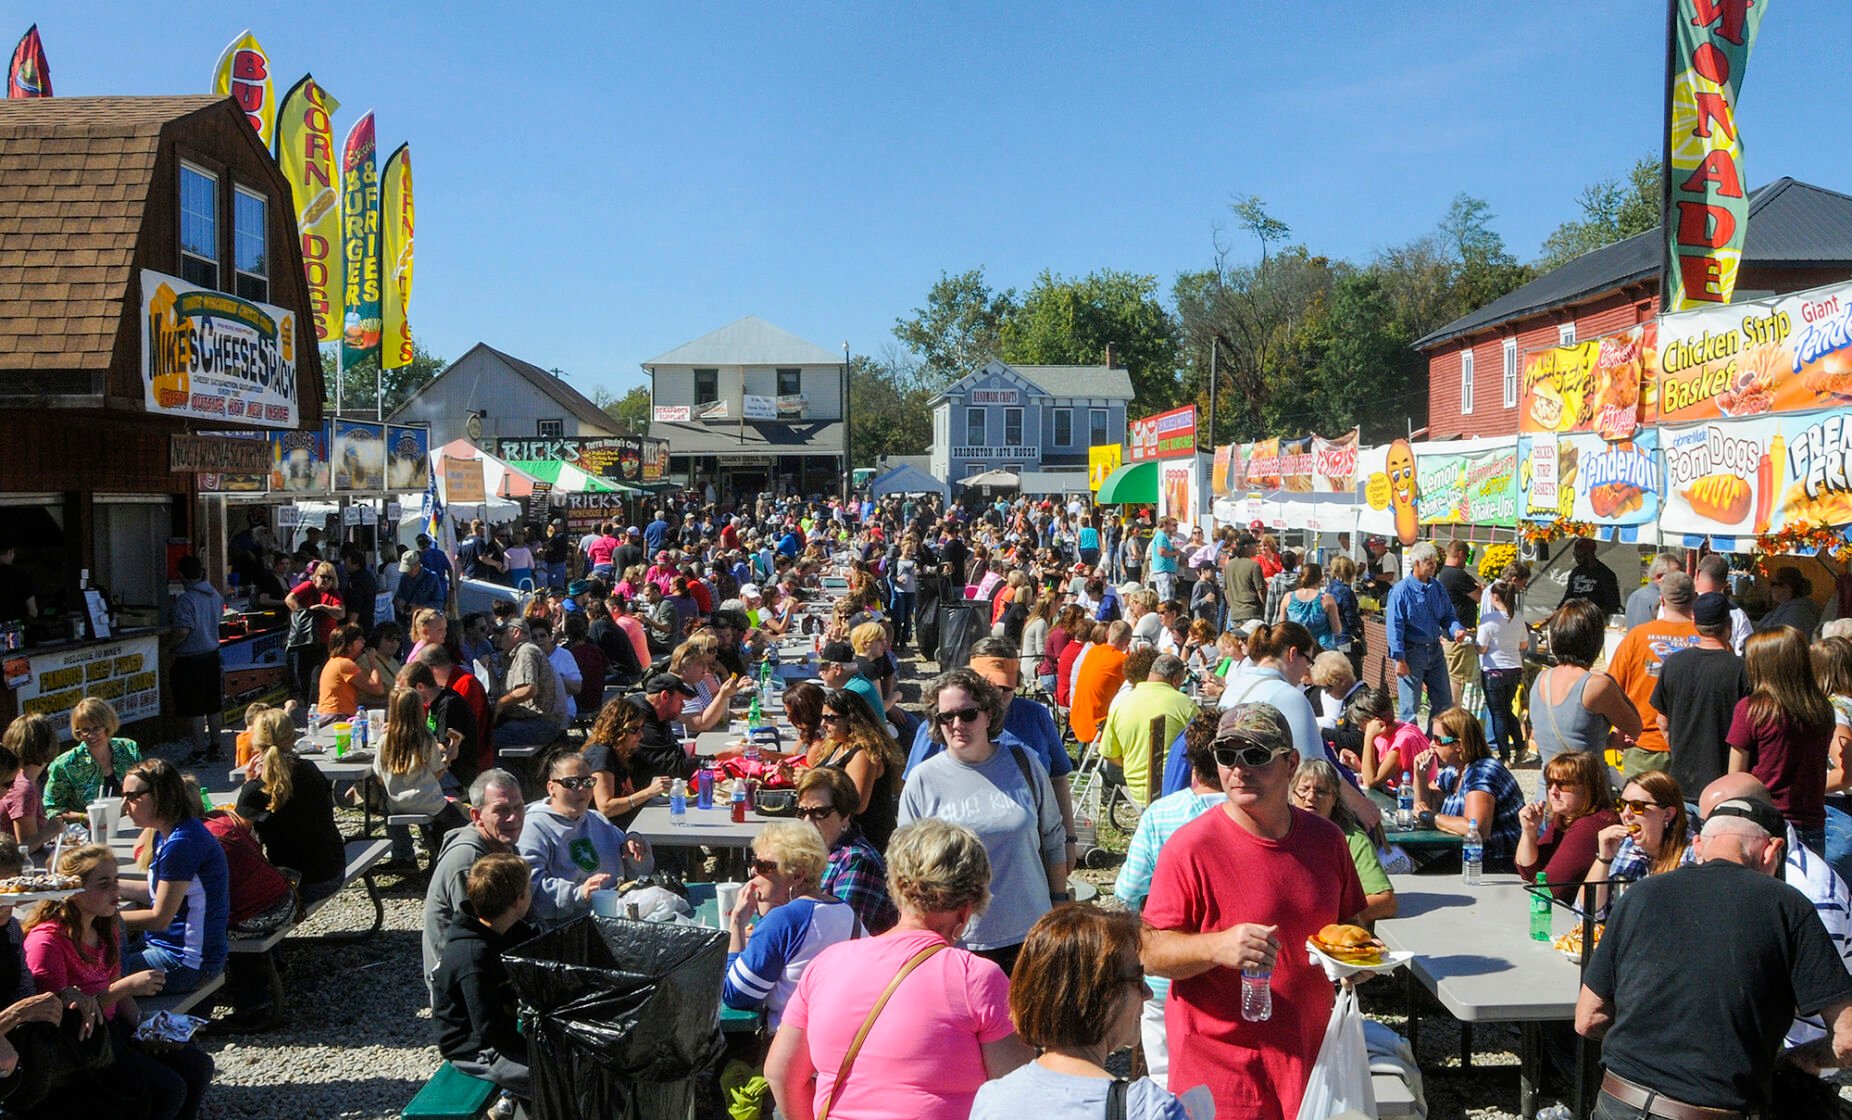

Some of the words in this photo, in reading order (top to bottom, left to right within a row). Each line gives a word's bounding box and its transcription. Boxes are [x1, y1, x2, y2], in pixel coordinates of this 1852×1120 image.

[304, 82, 330, 187] CORN
[344, 169, 365, 306] BURGER
[363, 186, 379, 302] FRIES
[1802, 294, 1839, 323] Giant
[1663, 328, 1739, 375] Chicken
[1742, 308, 1791, 349] Strip
[1664, 359, 1737, 413] Basket
[501, 439, 580, 461] RICK'S
[954, 447, 993, 457] BRIDGETON
[1014, 447, 1036, 457] HOUSE
[1534, 445, 1555, 459] CHICKEN
[1666, 443, 1712, 487] Corn
[1708, 426, 1760, 479] Dogs
[1421, 461, 1459, 497] Lemon
[1537, 464, 1551, 477] STRIP
[569, 492, 622, 509] RICK'S
[1419, 487, 1463, 520] Shake-Ups
[1534, 482, 1555, 496] BASKETS
[1471, 494, 1515, 523] Shake-Ups
[1648, 634, 1685, 643] HARLEY
